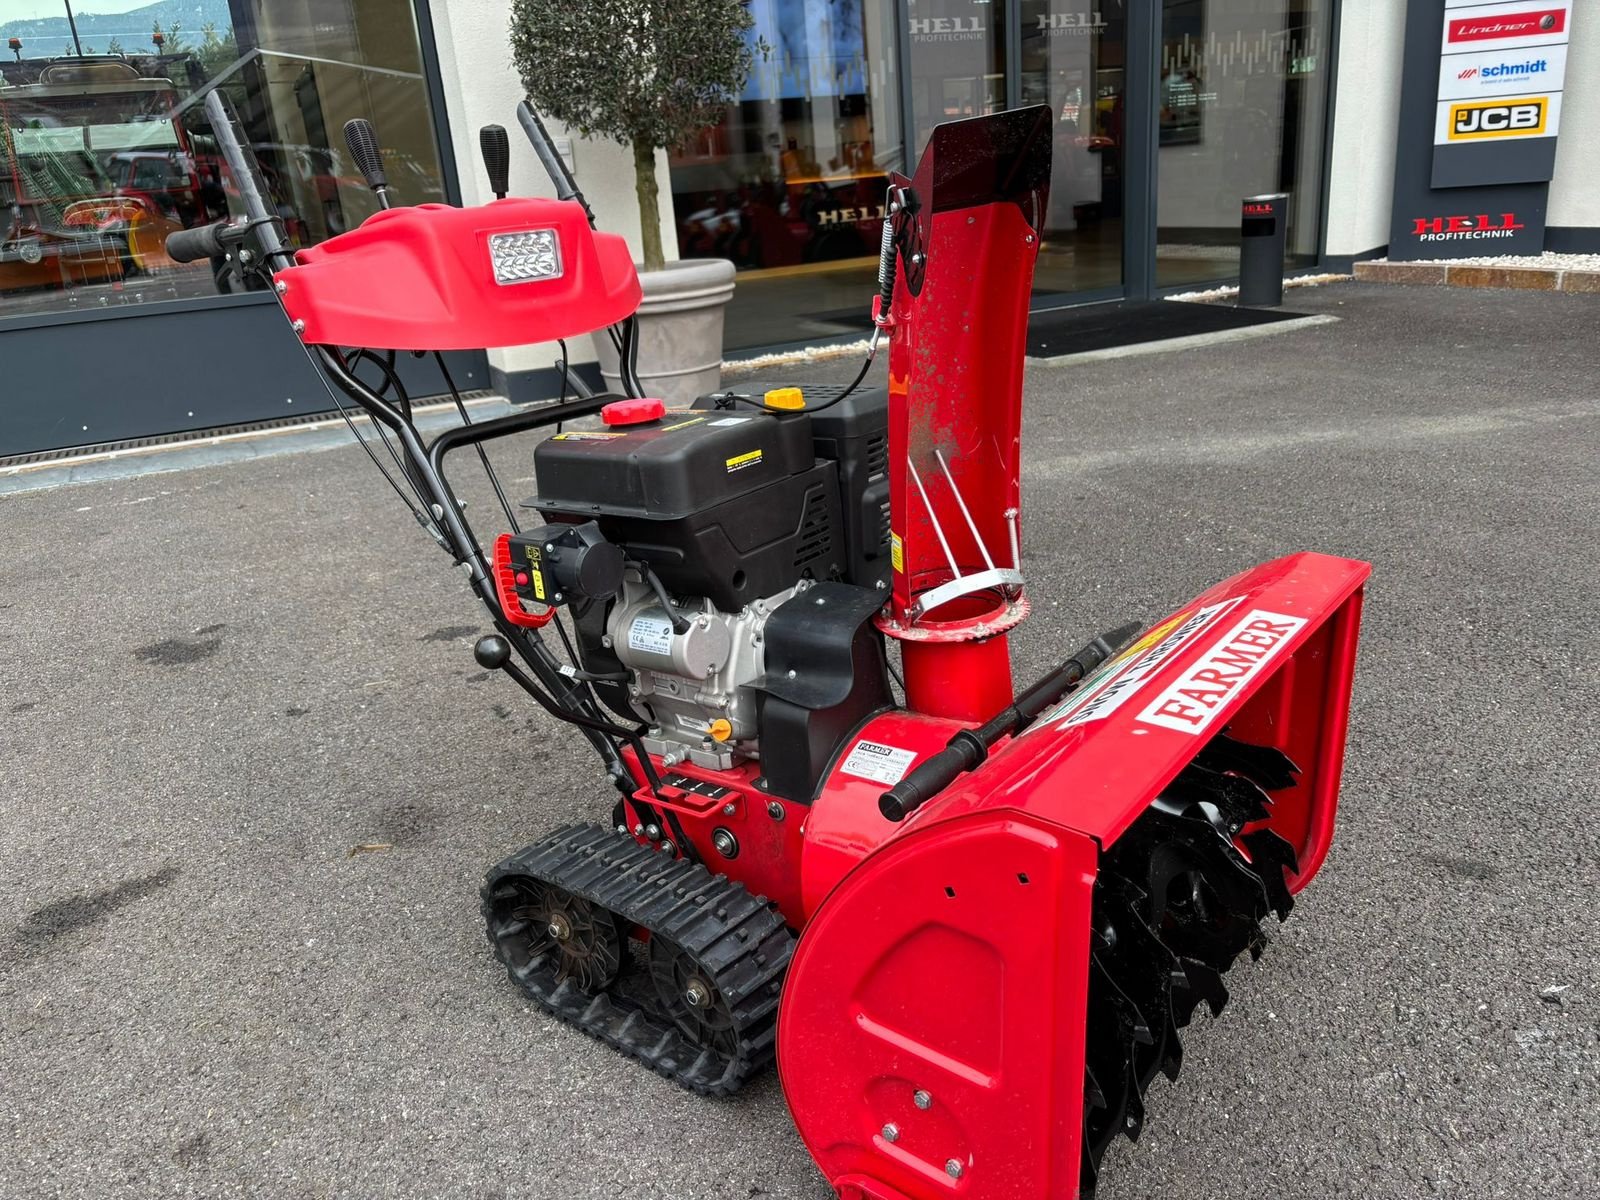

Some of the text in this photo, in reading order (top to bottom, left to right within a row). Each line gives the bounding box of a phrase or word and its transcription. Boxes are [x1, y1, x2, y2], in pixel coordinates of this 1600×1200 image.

[908, 17, 986, 34] HELL
[1036, 12, 1108, 30] HELL
[1457, 22, 1535, 36] Lindner
[914, 33, 983, 43] PROFITECHNIK
[1042, 27, 1105, 37] PROFITECHNIK
[1481, 59, 1547, 77] schmidt
[1456, 105, 1539, 132] JCB
[1411, 213, 1525, 235] HELL
[1420, 229, 1514, 242] PROFITECHNIK
[1153, 619, 1296, 726] FARMER
[1068, 677, 1133, 724] SNOW
[859, 743, 892, 756] FARMER
